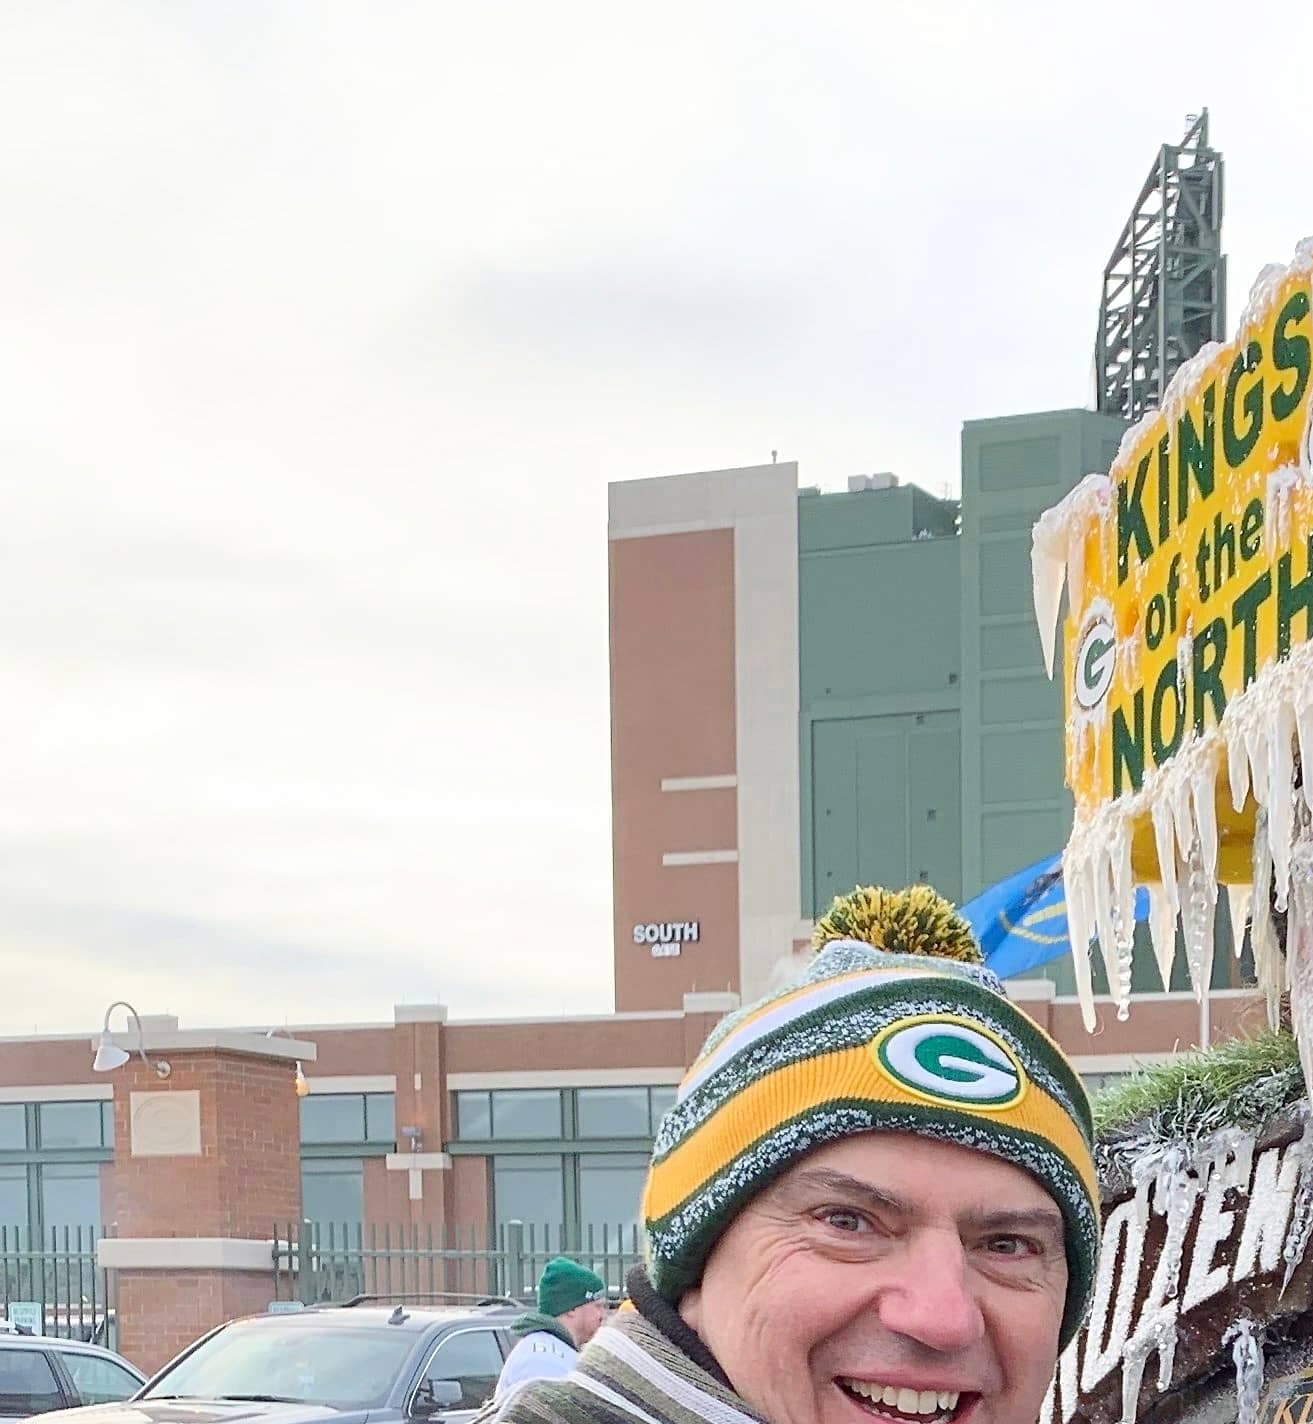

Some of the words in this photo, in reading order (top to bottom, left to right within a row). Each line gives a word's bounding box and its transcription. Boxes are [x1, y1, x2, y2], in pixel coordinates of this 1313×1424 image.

[1116, 290, 1311, 588] KINGS
[1146, 570, 1180, 652] of
[1196, 493, 1264, 582] the
[632, 921, 700, 944] SOUTH
